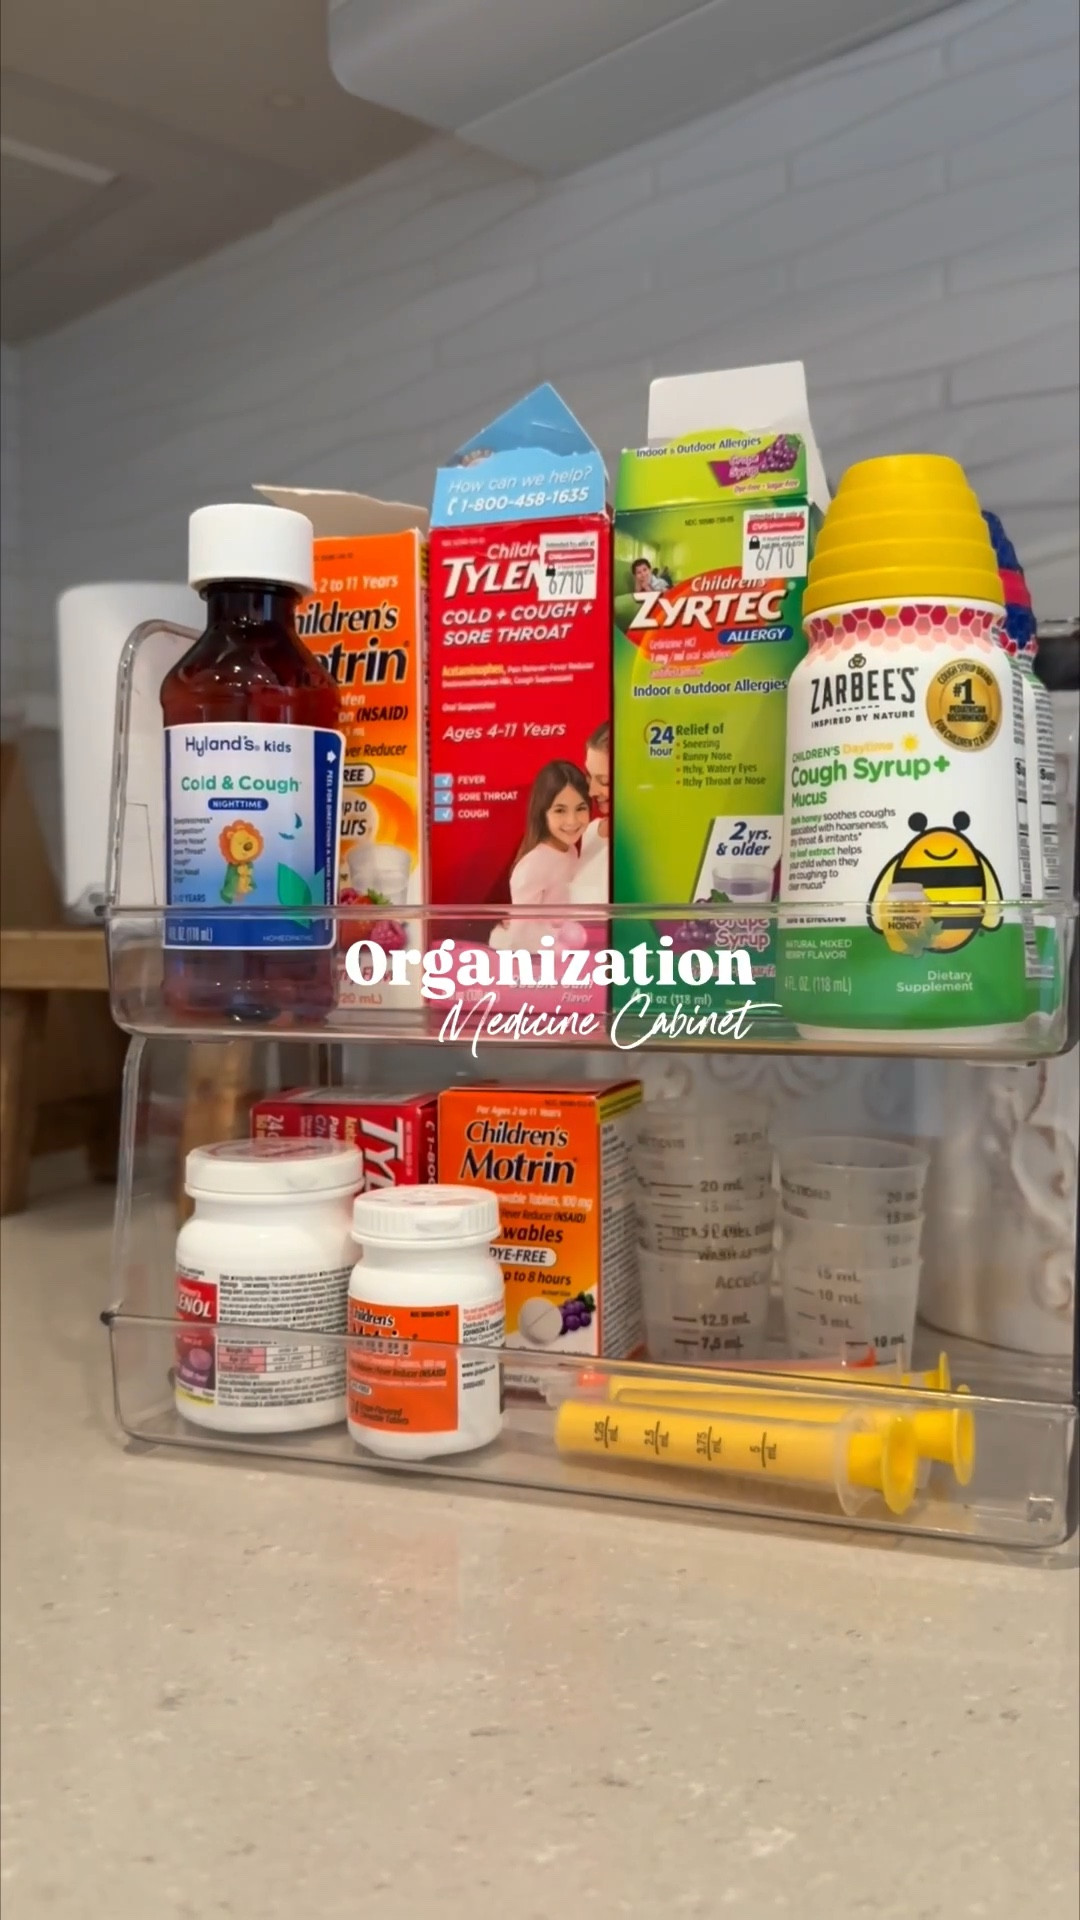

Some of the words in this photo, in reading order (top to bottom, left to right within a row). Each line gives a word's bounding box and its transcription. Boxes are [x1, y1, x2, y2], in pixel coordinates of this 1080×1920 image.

[636, 447, 667, 458] Indoor
[677, 442, 716, 454] Outdoor
[719, 437, 761, 450] Allergies
[449, 479, 482, 494] How
[488, 475, 516, 489] can
[522, 473, 544, 486] we
[550, 466, 592, 485] help?
[461, 487, 590, 513] 1-800-458-1635
[487, 542, 541, 561] Childr
[320, 579, 328, 592] 2
[330, 578, 343, 591] to
[346, 577, 359, 590] 11
[362, 575, 398, 590] Years
[441, 556, 541, 600] TYLEN
[442, 608, 492, 626] COLD
[510, 602, 578, 623] COUGH
[629, 589, 788, 630] ZYRTEC
[443, 627, 491, 647] SORE
[497, 623, 573, 643] THROAT
[727, 628, 786, 643] ALLERGY
[316, 637, 408, 684] trin
[634, 684, 671, 697] Indoor
[683, 680, 730, 695] Outdoor
[734, 677, 787, 694] Allergies
[811, 667, 916, 716] ZARBEE'S
[953, 678, 976, 705] #1
[356, 706, 408, 722] (NSAID)
[811, 716, 851, 729] INSPIRED
[855, 713, 868, 723] BY
[873, 710, 915, 721] NATURE
[443, 725, 482, 742] Ages
[486, 722, 517, 738] 4-11
[523, 722, 566, 737] Years
[649, 726, 675, 746] 24
[676, 723, 709, 736] Relief
[712, 722, 724, 735] of
[185, 735, 255, 757] Hyland's
[264, 740, 291, 753] kids
[363, 744, 408, 758] Reducer
[649, 746, 673, 757] hour
[682, 739, 721, 750] Sneezing
[792, 746, 841, 763] CHILDREN'S
[843, 741, 894, 757] Daytime
[682, 752, 709, 763] Runny
[711, 751, 732, 760] Nose
[707, 763, 736, 775] Watery
[738, 763, 757, 773] Eyes
[791, 757, 847, 788] Cough
[181, 775, 216, 791] Cold
[222, 775, 234, 790] &
[238, 775, 299, 794] Cough
[457, 775, 486, 785] FEVER
[682, 777, 703, 788] Itchy
[705, 776, 731, 786] Throat
[733, 777, 742, 785] or
[745, 775, 766, 785] Nose
[457, 792, 481, 801] SORE
[483, 790, 518, 800] THROAT
[212, 799, 263, 809] NIGHTTIME
[354, 800, 367, 813] to
[457, 809, 489, 819] COUGH
[823, 810, 857, 821] soothes
[858, 808, 896, 819] coughs
[729, 821, 747, 841] 2
[748, 829, 772, 843] yrs.
[818, 823, 835, 832] with
[835, 820, 888, 832] hoarseness,
[715, 843, 727, 856] &
[731, 842, 770, 856] older
[808, 846, 836, 857] extract
[837, 845, 862, 856] helps
[816, 858, 837, 867] when
[838, 857, 859, 868] they
[829, 869, 839, 877] to
[888, 921, 921, 930] HONEY
[715, 929, 770, 951] Syrup
[819, 938, 853, 948] MIXED
[807, 950, 847, 960] FLAVOR
[927, 969, 972, 983] Dietary
[896, 980, 973, 994] Supplement
[561, 991, 593, 1003] Flavor
[656, 995, 667, 1005] oz
[670, 994, 691, 1006] (118
[693, 993, 712, 1006] ml)
[465, 1119, 568, 1148] Children's
[459, 1147, 575, 1184] Motrin
[700, 1180, 719, 1193] 20
[503, 1223, 563, 1244] wables
[489, 1246, 547, 1264] DYE-FREE
[513, 1270, 525, 1282] to
[527, 1270, 536, 1283] 8
[537, 1270, 572, 1286] hours
